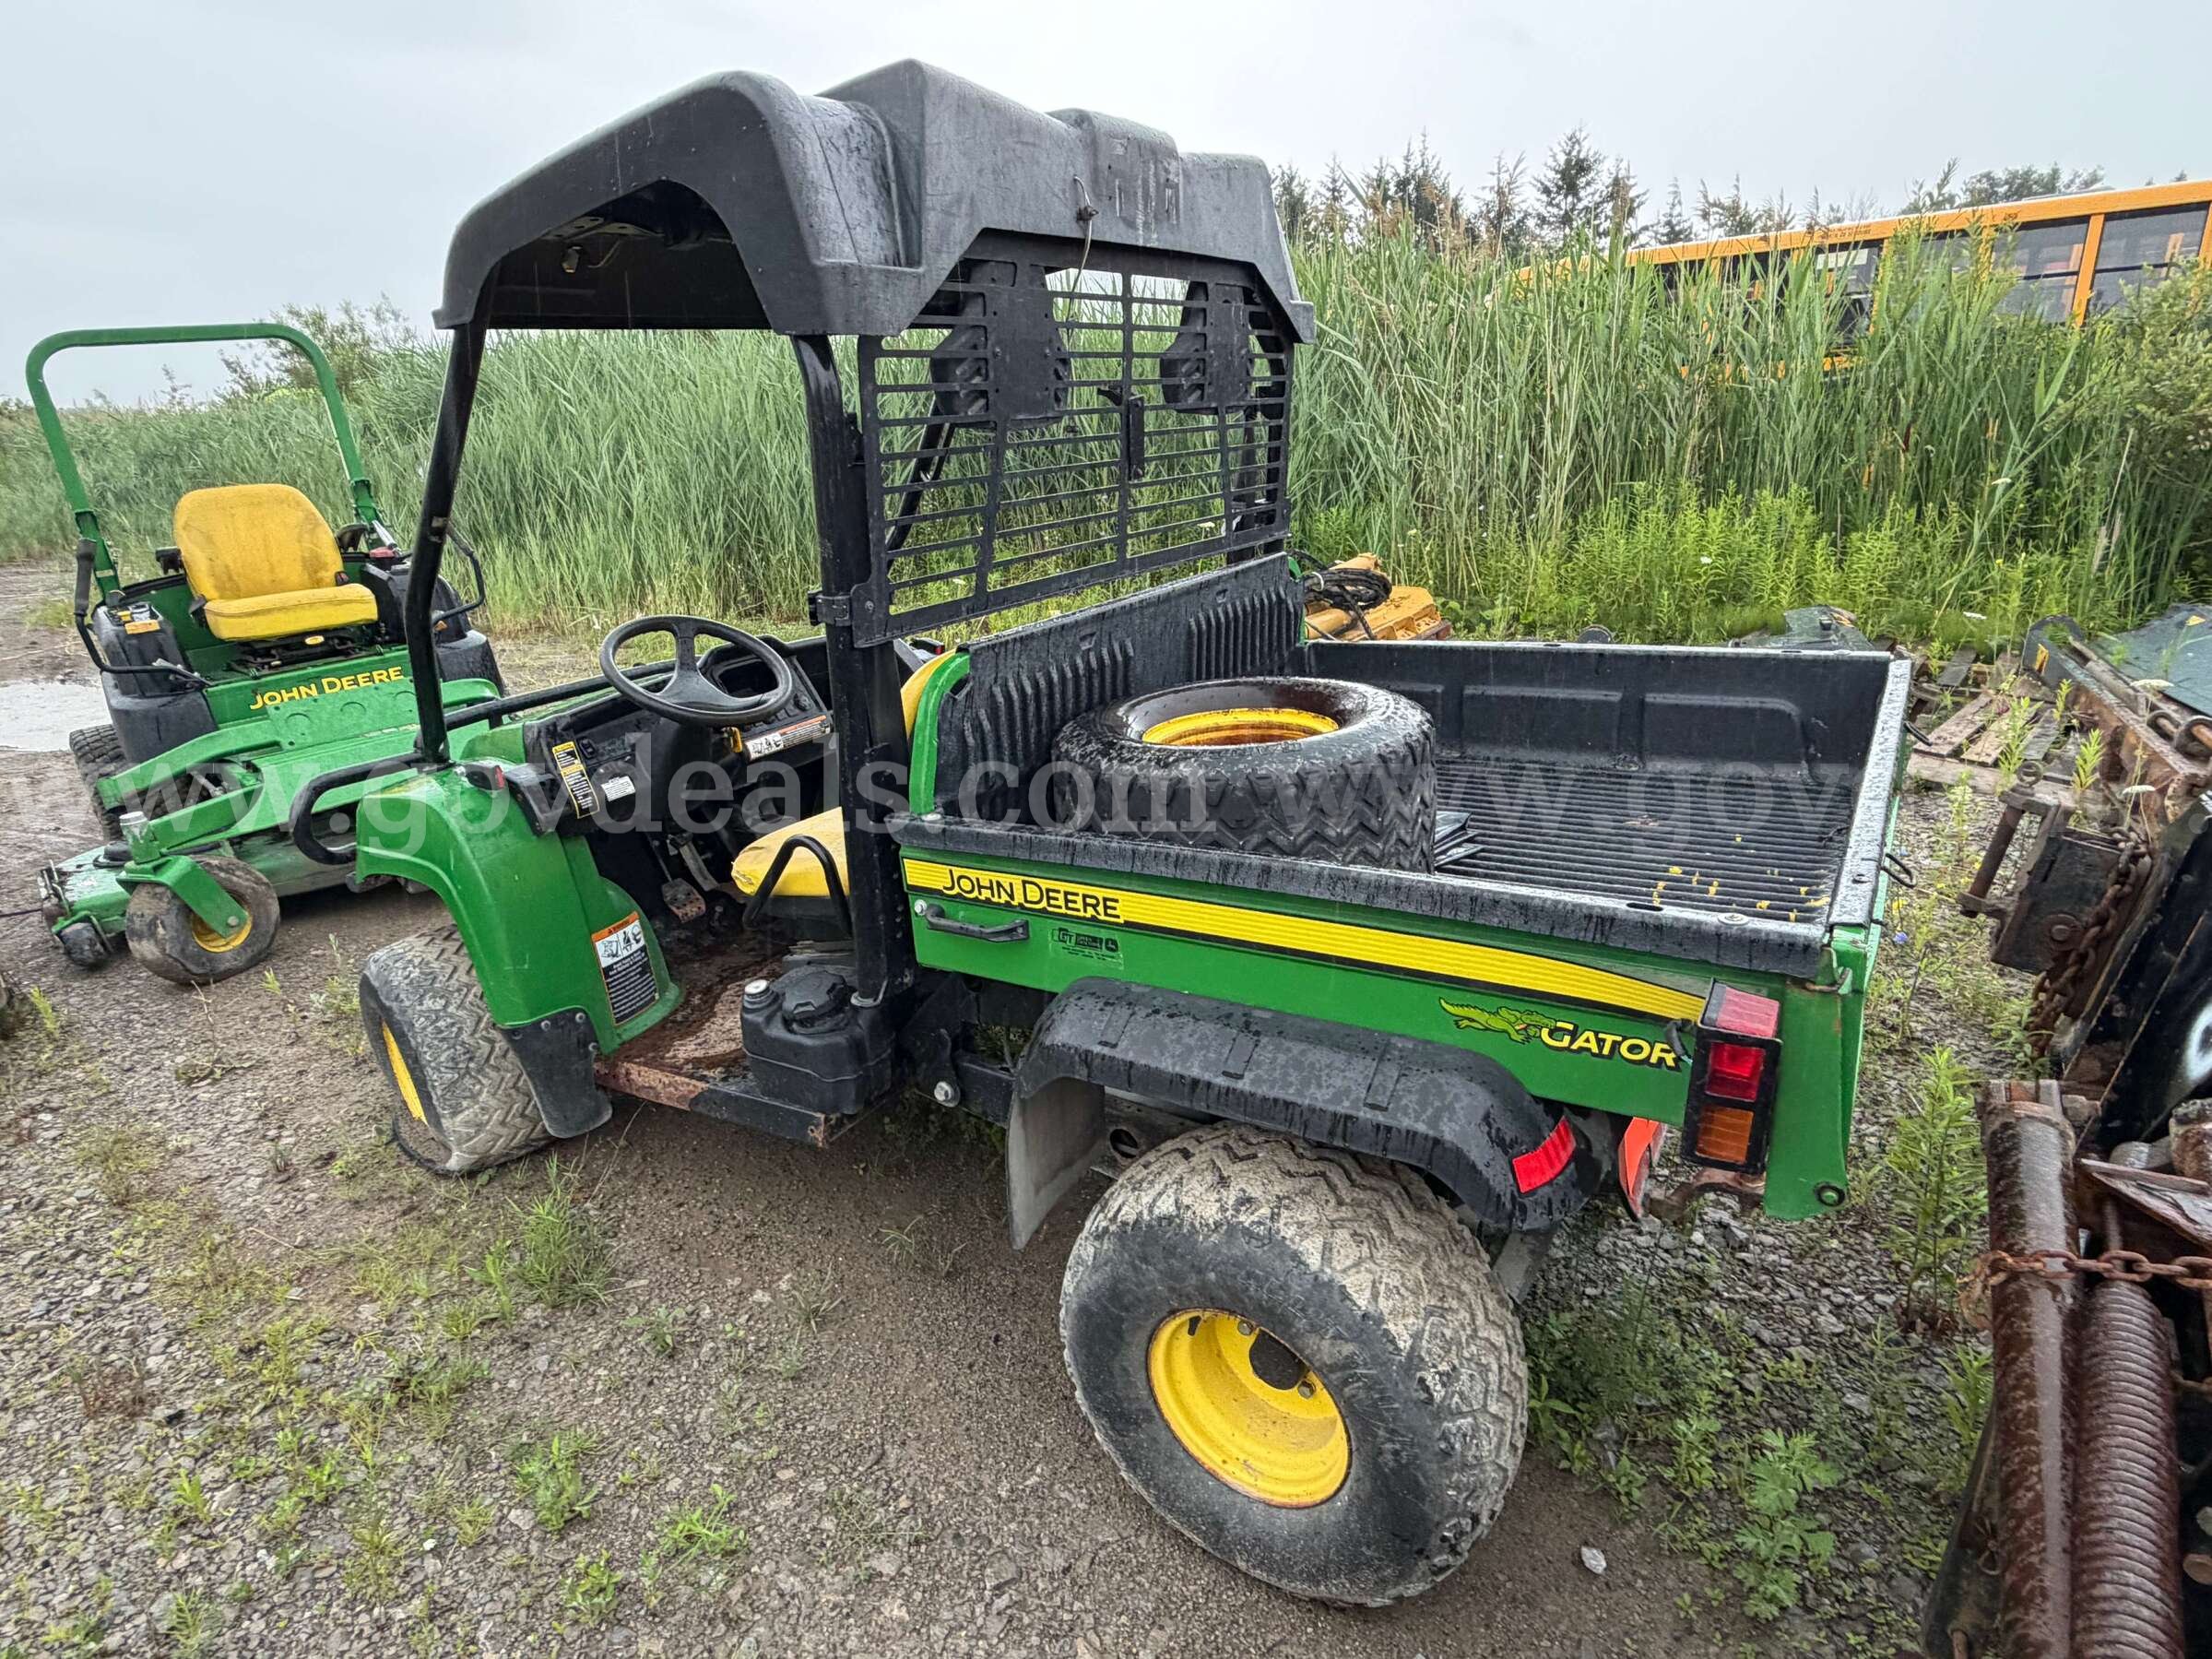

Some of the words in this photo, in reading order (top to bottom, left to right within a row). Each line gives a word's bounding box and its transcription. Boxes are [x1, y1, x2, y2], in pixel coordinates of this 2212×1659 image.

[250, 683, 319, 710] JOHN
[321, 666, 404, 693] DEERE
[942, 869, 1016, 902] JOHN
[1021, 879, 1121, 919] DEERE
[1540, 1021, 1679, 1070] GATOR
